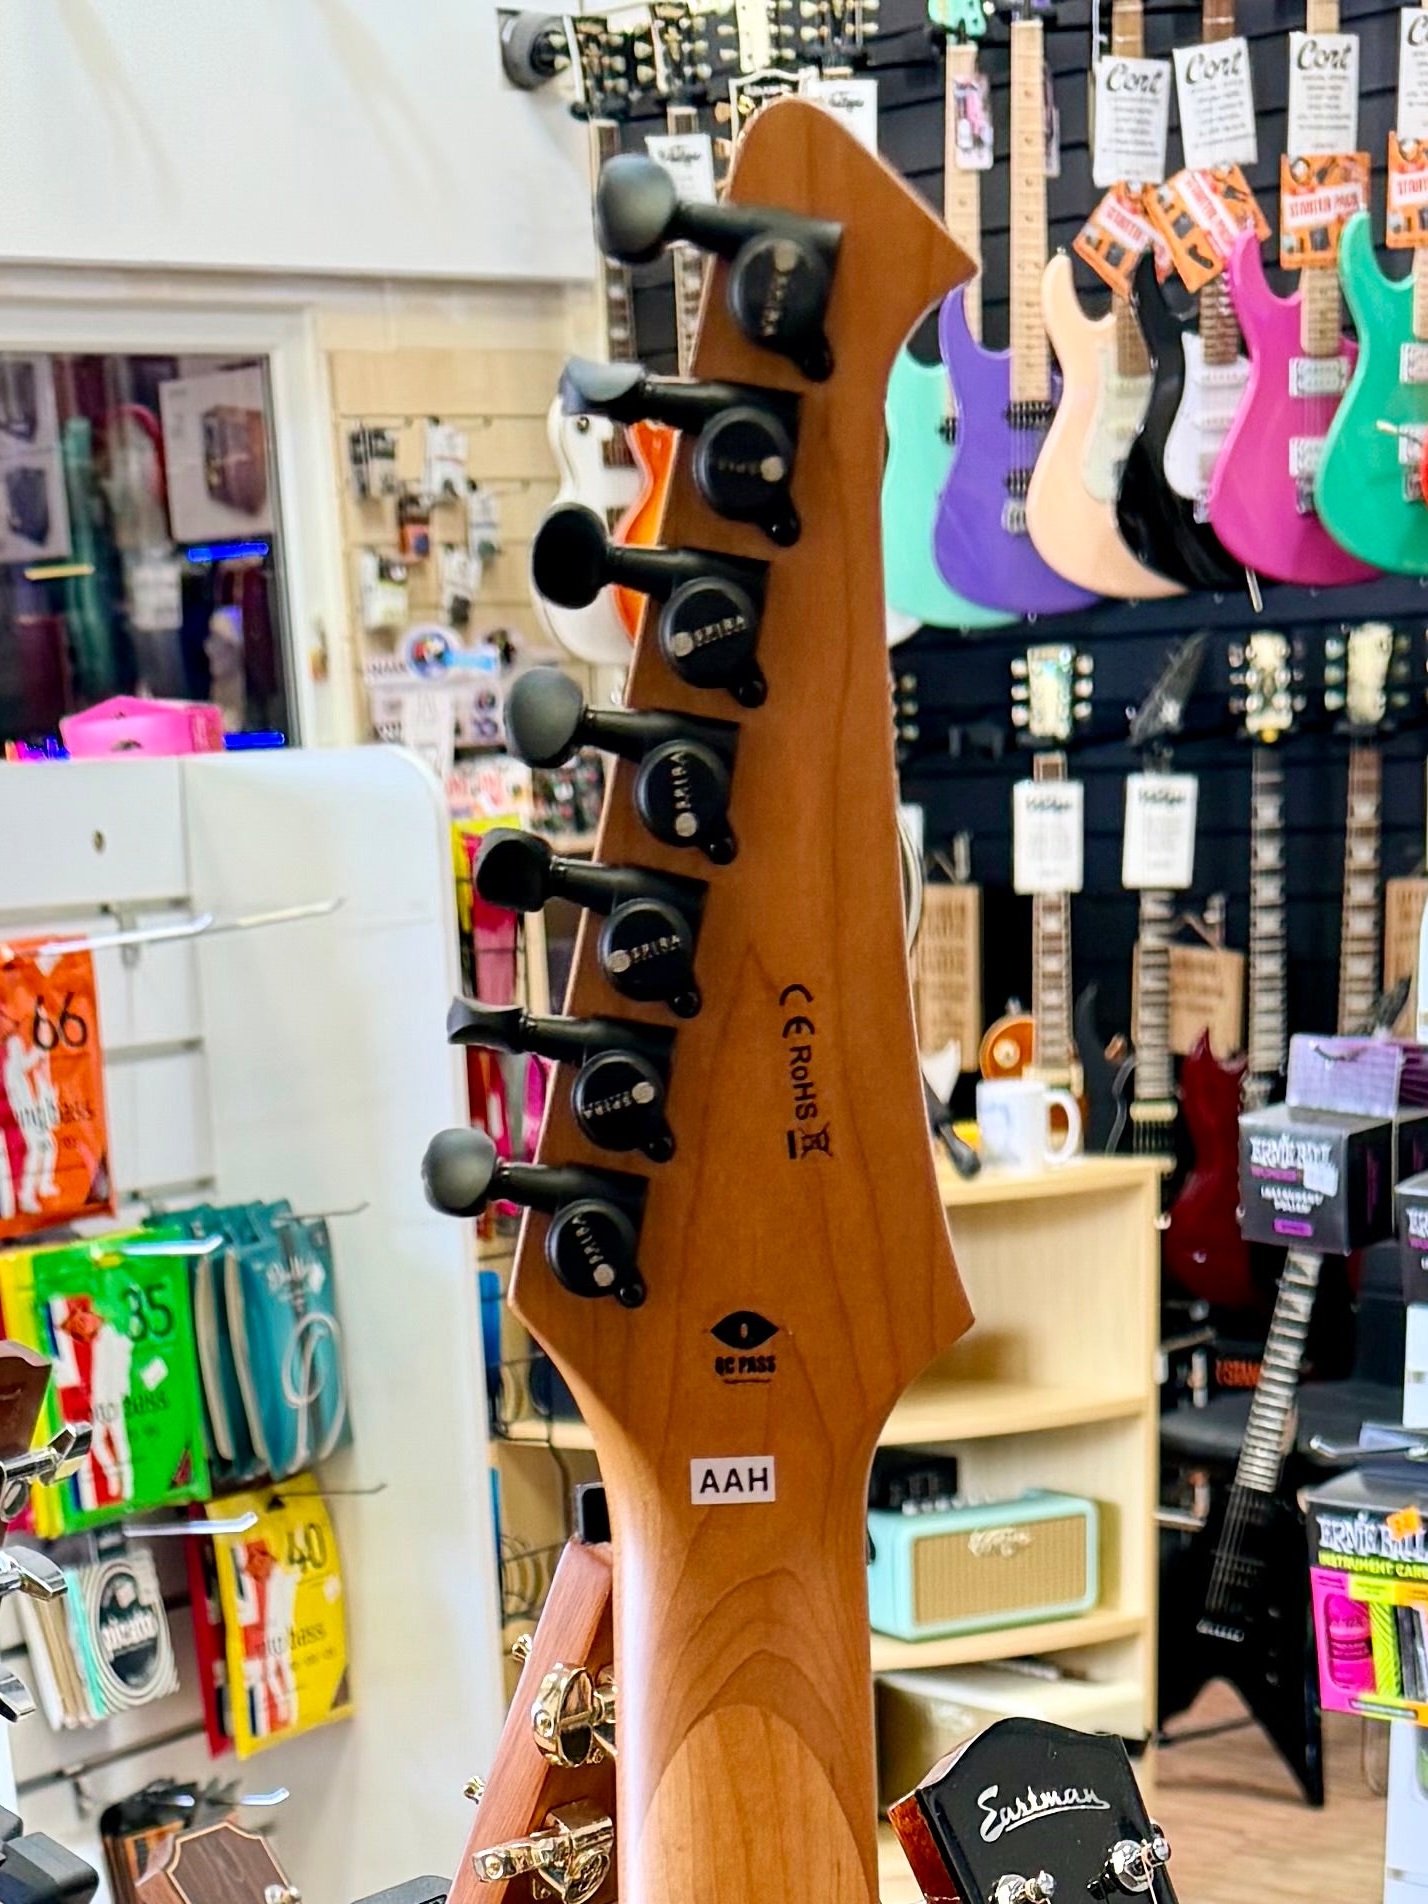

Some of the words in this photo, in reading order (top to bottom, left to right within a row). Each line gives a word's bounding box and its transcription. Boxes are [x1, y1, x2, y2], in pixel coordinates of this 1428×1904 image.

[788, 1044, 820, 1121] RoHS
[122, 1283, 174, 1343] 35
[715, 1356, 735, 1376] QC
[737, 1354, 777, 1376] PASS
[698, 1467, 769, 1495] AAH
[1315, 1510, 1380, 1556] ERNIE
[1317, 1550, 1394, 1575] INSTRUMENT
[977, 1784, 1111, 1843] Eastman
